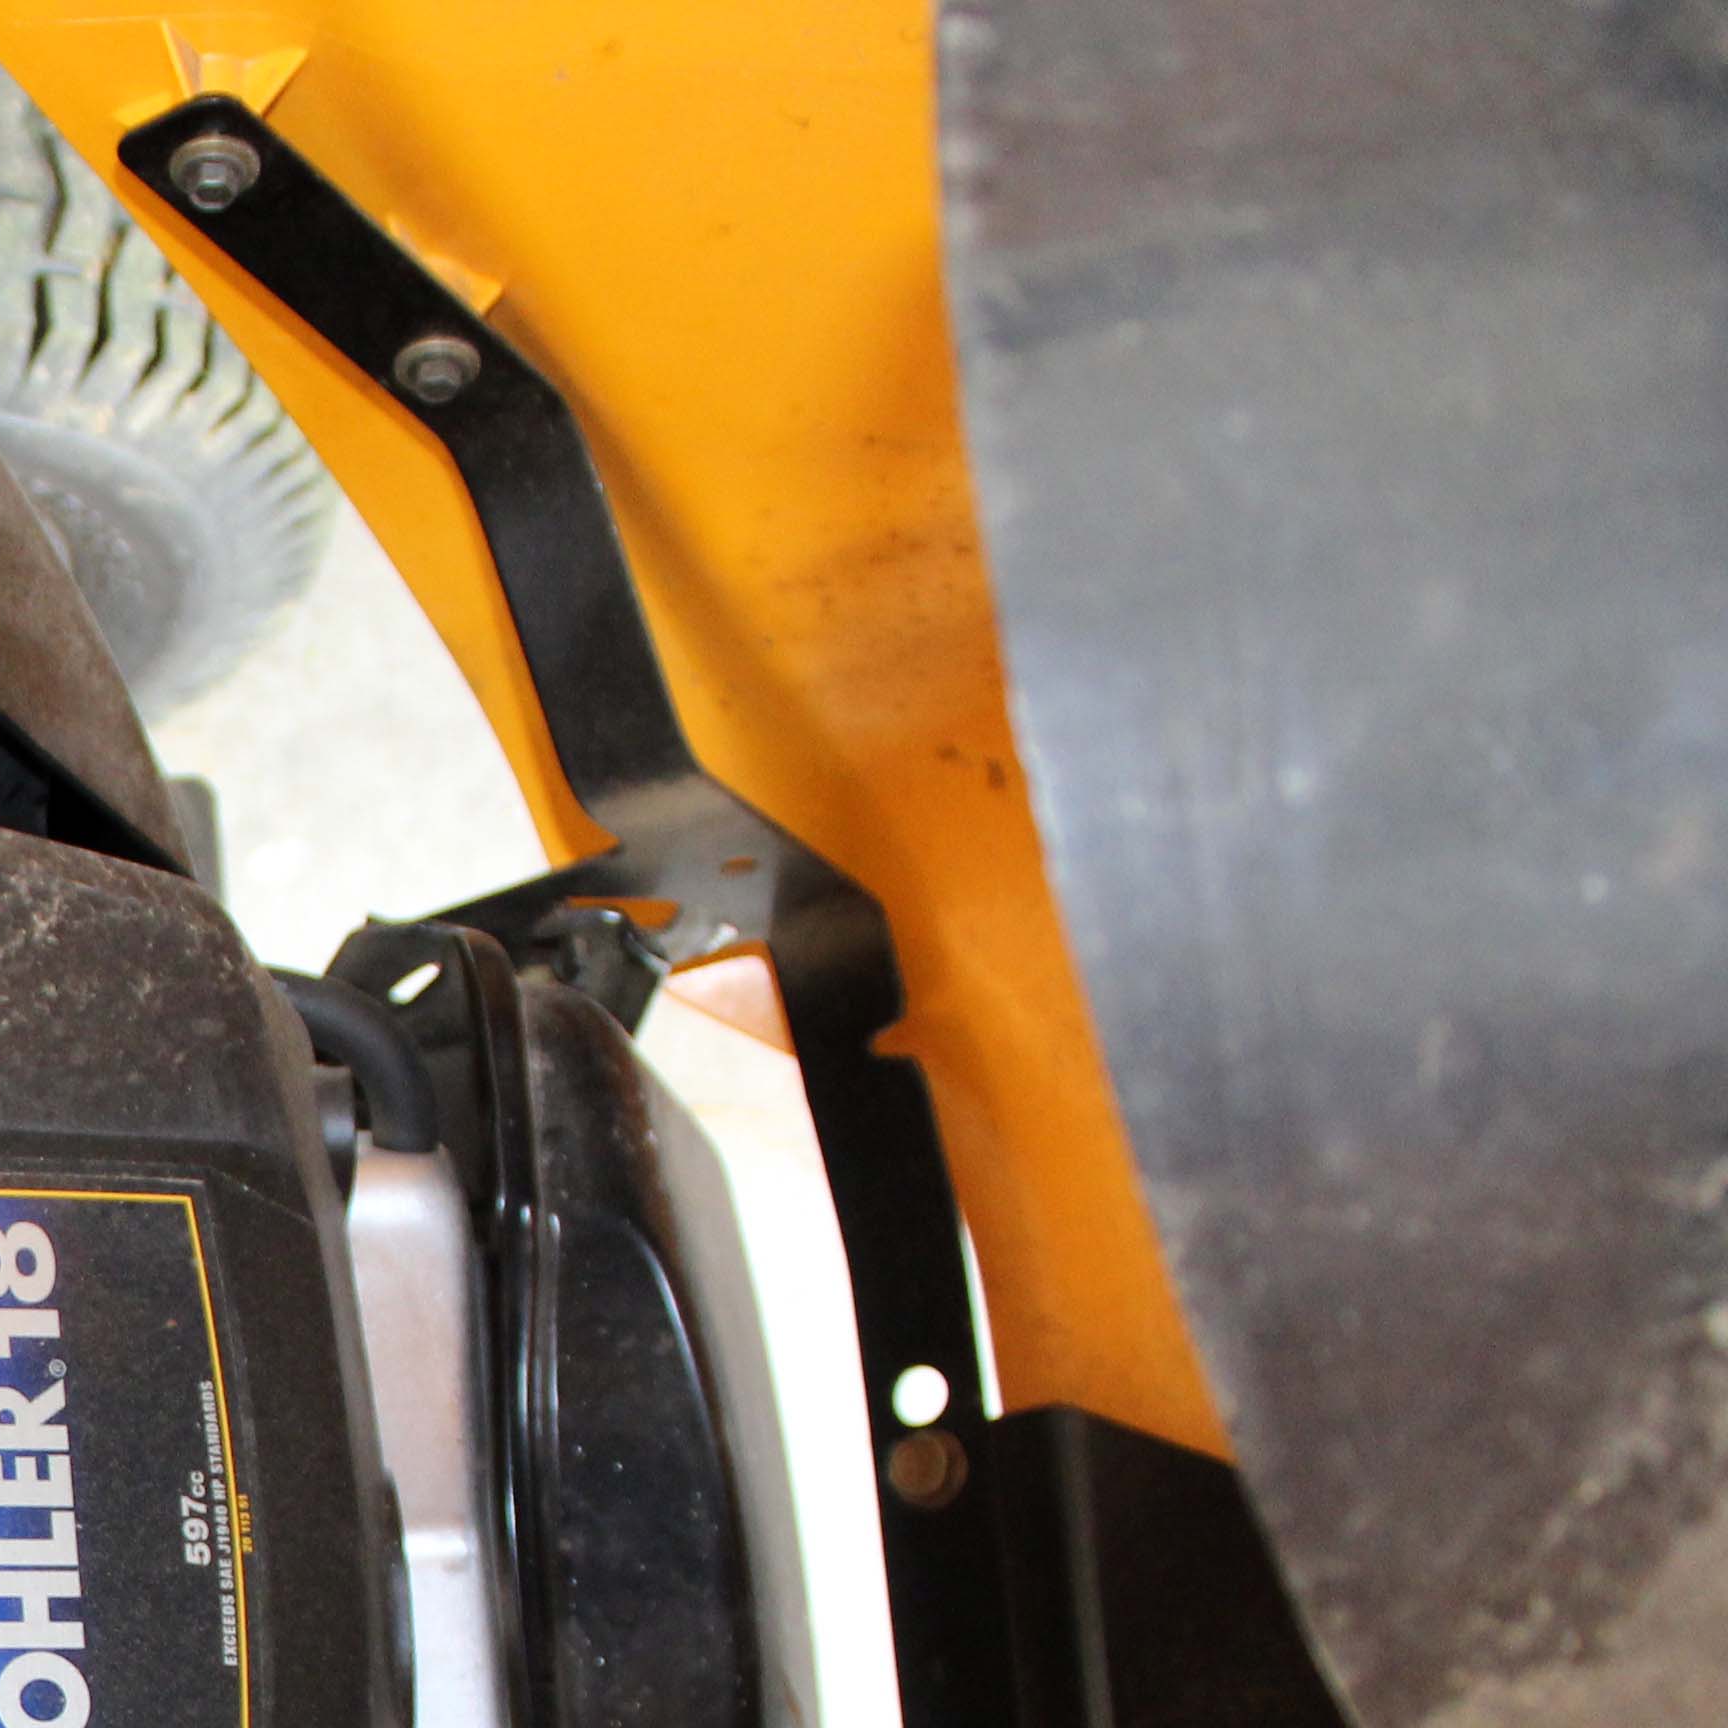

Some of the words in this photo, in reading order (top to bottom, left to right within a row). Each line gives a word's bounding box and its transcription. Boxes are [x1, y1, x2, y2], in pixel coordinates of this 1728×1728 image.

[199, 1380, 224, 1474] STANDARDS
[181, 1471, 211, 1566] 597cc
[219, 1558, 234, 1590] SAE
[223, 1594, 238, 1666] EXCEEDS
